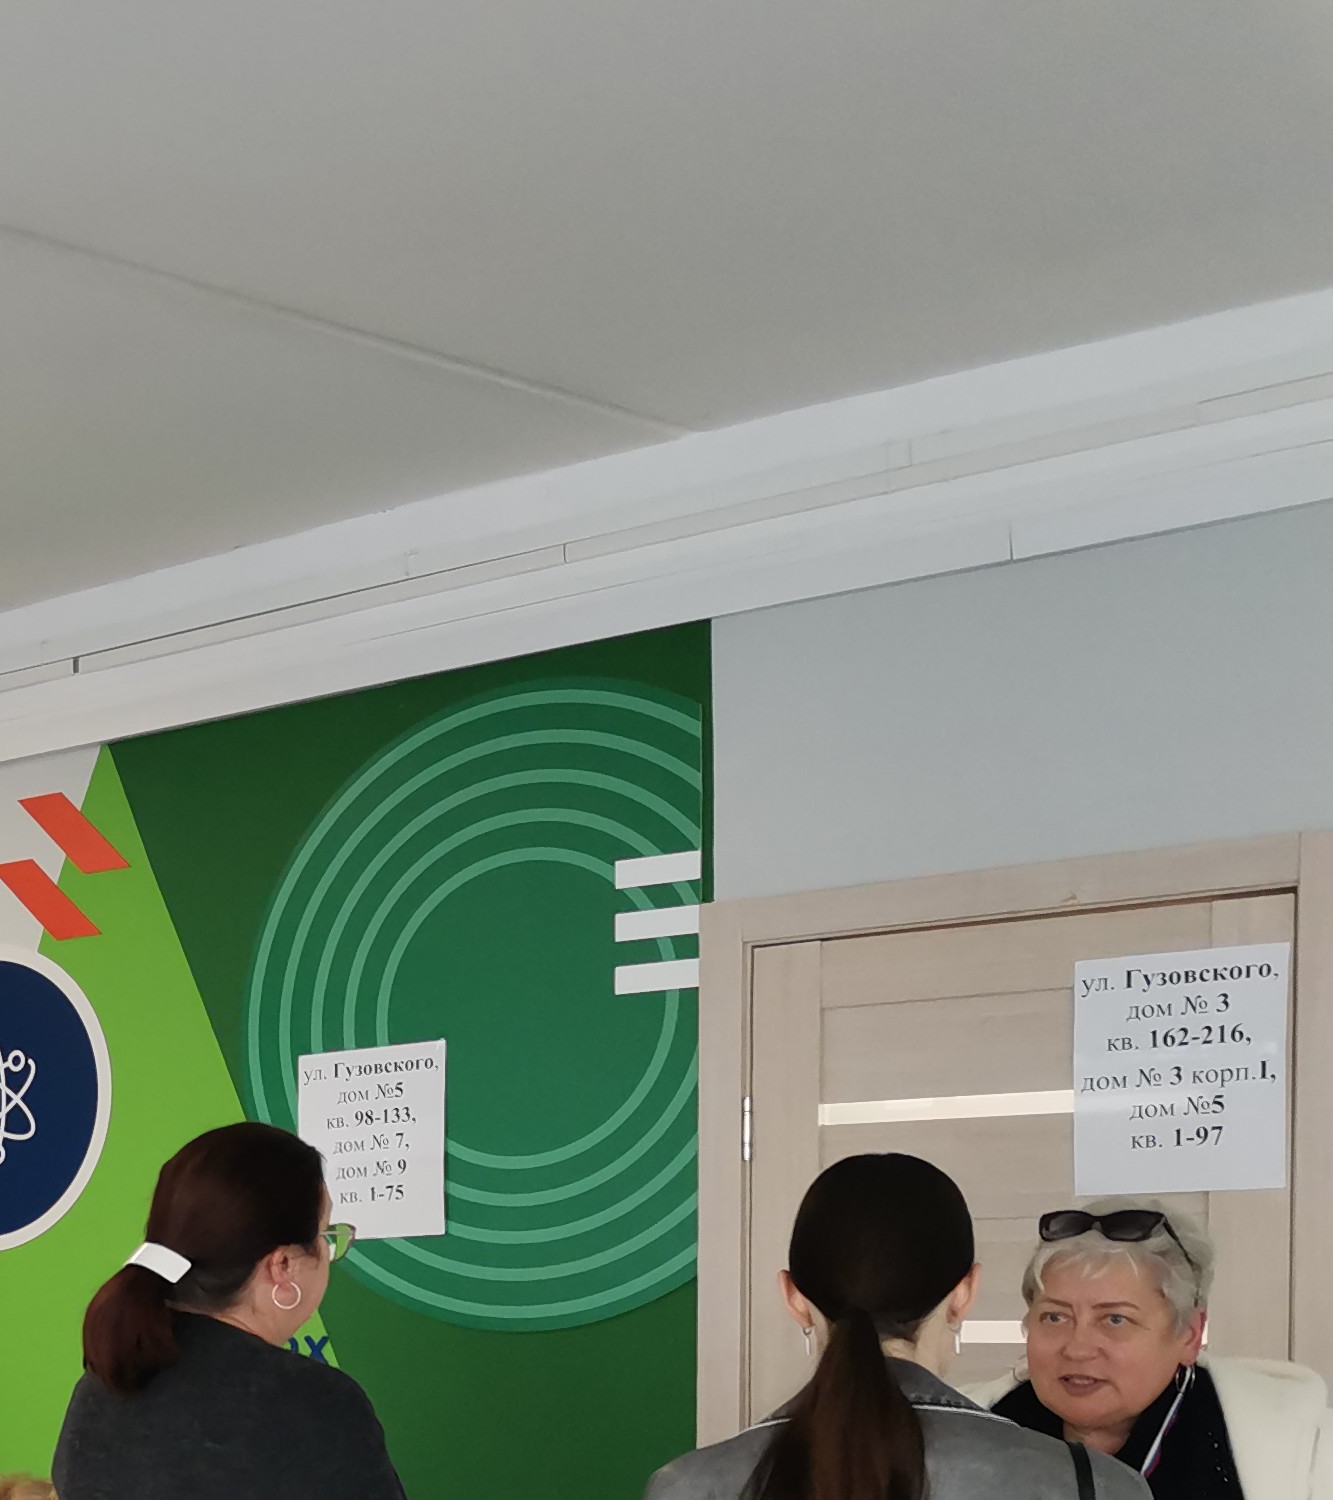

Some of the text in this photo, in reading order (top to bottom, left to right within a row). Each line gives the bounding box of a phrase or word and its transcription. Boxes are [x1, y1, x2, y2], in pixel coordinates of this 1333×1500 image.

[1081, 962, 1280, 998] ул. Гузовского,
[1126, 993, 1230, 1022] дом № 3
[1107, 1023, 1252, 1052] кв. 162-216,
[303, 1056, 440, 1086] ул. Гузовского,
[1081, 1074, 1128, 1093] дом
[1135, 1067, 1162, 1088] №
[1169, 1065, 1183, 1086] 3
[337, 1081, 405, 1105] дом №5
[327, 1106, 418, 1130] кв. 98-133,
[1129, 1094, 1226, 1121] дом №5
[333, 1132, 411, 1155] дом № 7,
[1131, 1125, 1224, 1150] кв. 1-97
[335, 1158, 407, 1181] дом № 9
[339, 1184, 405, 1205] кв. 1-75
